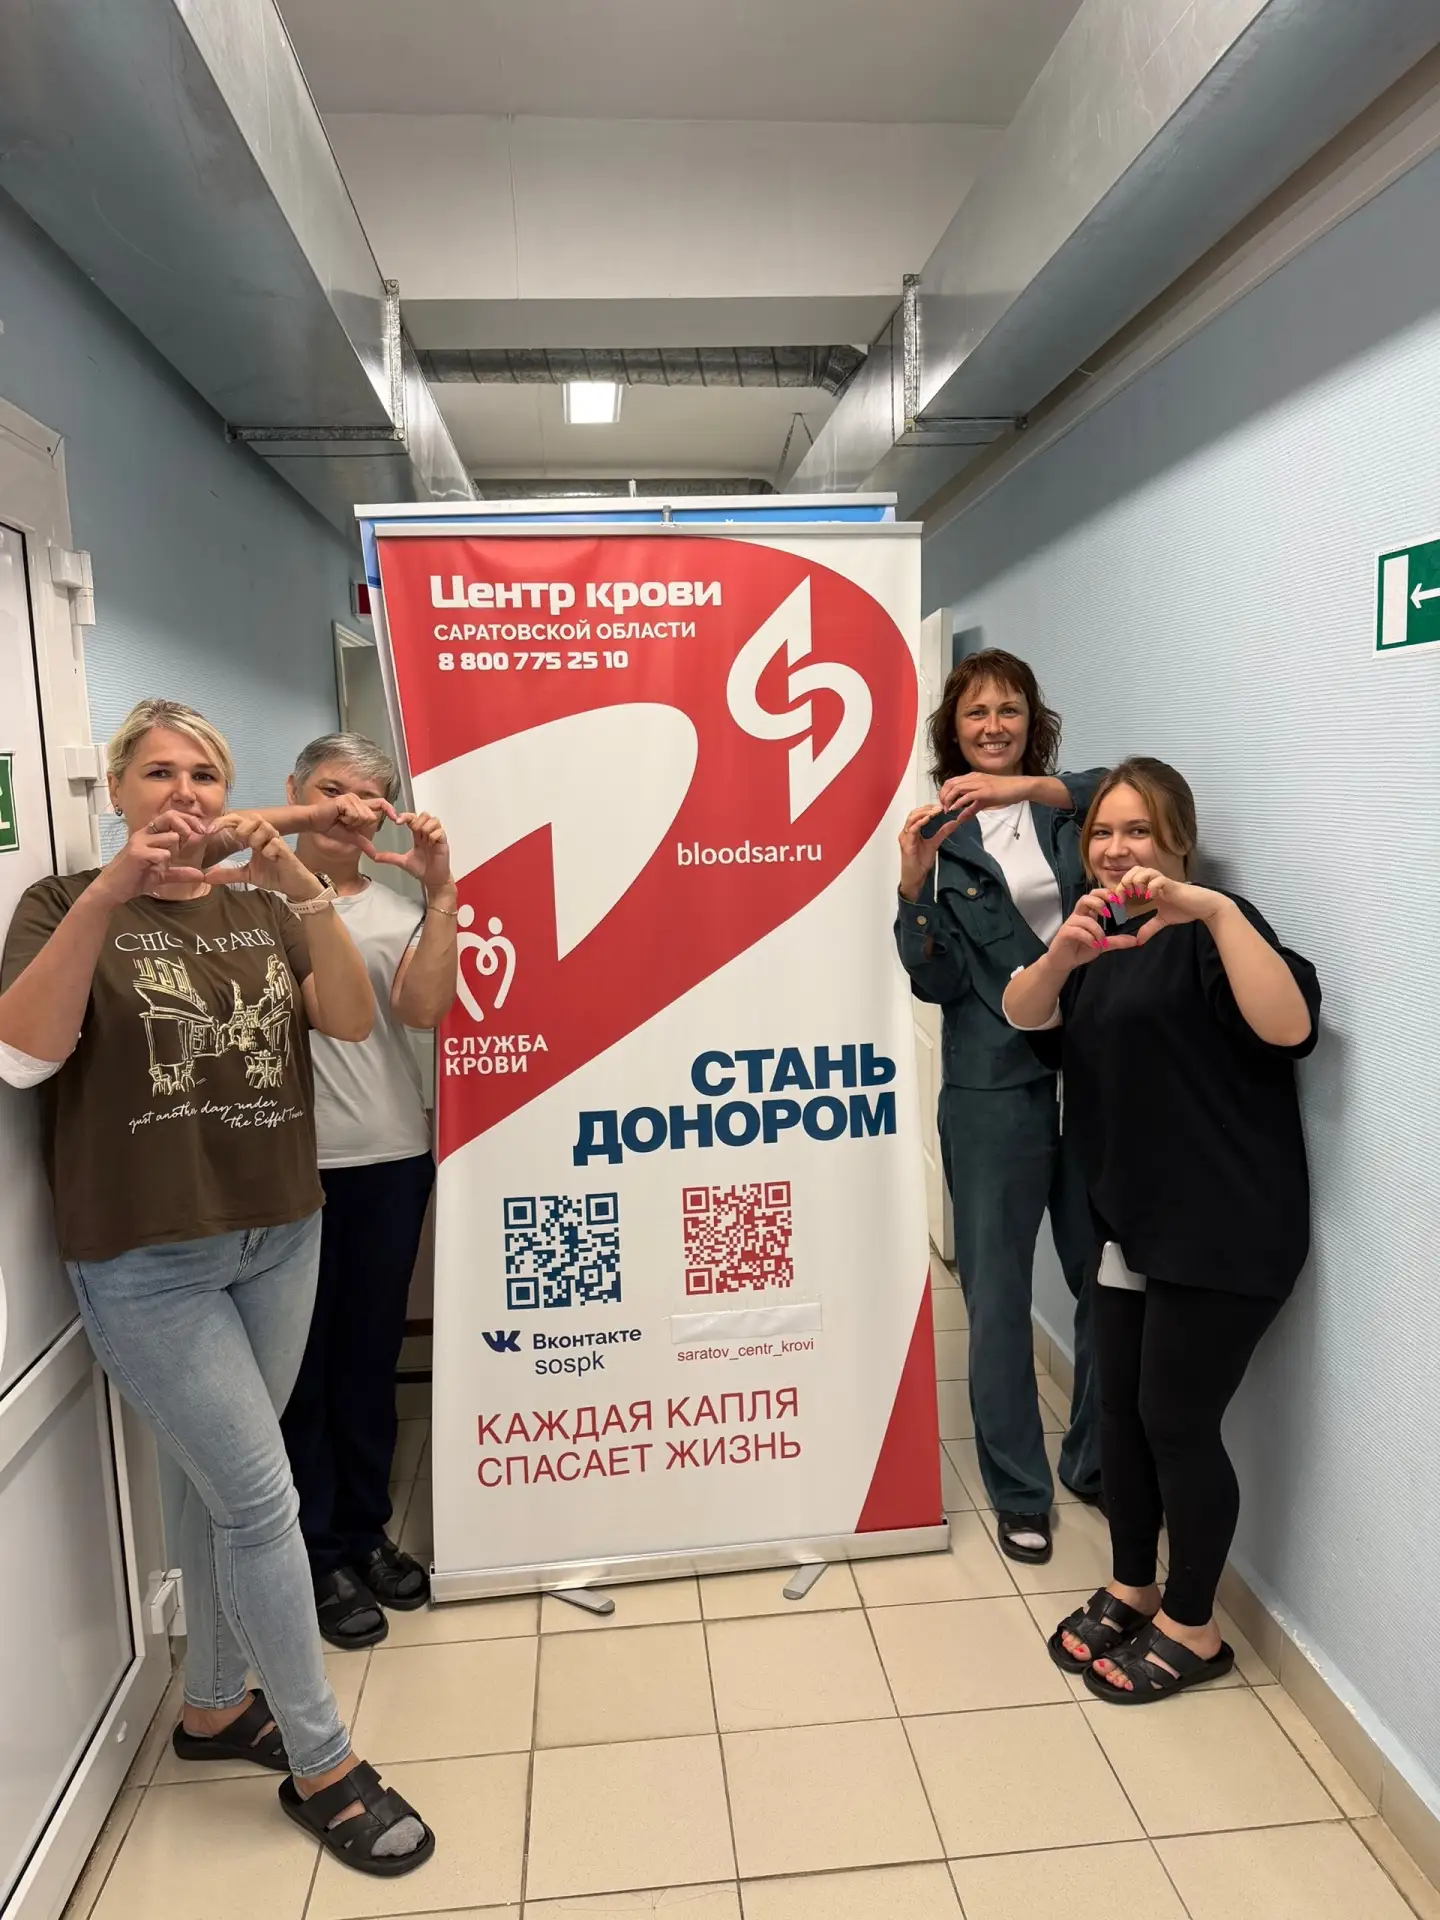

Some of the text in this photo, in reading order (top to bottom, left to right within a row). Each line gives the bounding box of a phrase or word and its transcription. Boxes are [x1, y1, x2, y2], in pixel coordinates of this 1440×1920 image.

[430, 575, 722, 615] Центр крови
[433, 619, 696, 641] САРАТОВСКОЙ ОБЛАСТИ
[438, 650, 629, 670] 8 800 775 25 10
[677, 840, 822, 865] bloodsar.ru
[195, 934, 213, 954] A
[213, 928, 275, 952] PARIS
[444, 1034, 548, 1055] СЛУЖБА
[445, 1055, 527, 1075] КРОВИ
[691, 1043, 897, 1096] СТАНЬ
[129, 1111, 154, 1134] just
[200, 1100, 232, 1120] day
[234, 1096, 277, 1110] under
[254, 1109, 286, 1128] Eiffel
[573, 1092, 897, 1166] ДОНОРОМ
[677, 1338, 814, 1362] saratov_centr_krovi
[535, 1351, 605, 1377] sospk
[478, 1387, 799, 1446] КАЖДАЯ КАПЛЯ
[478, 1431, 802, 1486] СПАСАЕТ ЖИЗНЬ
